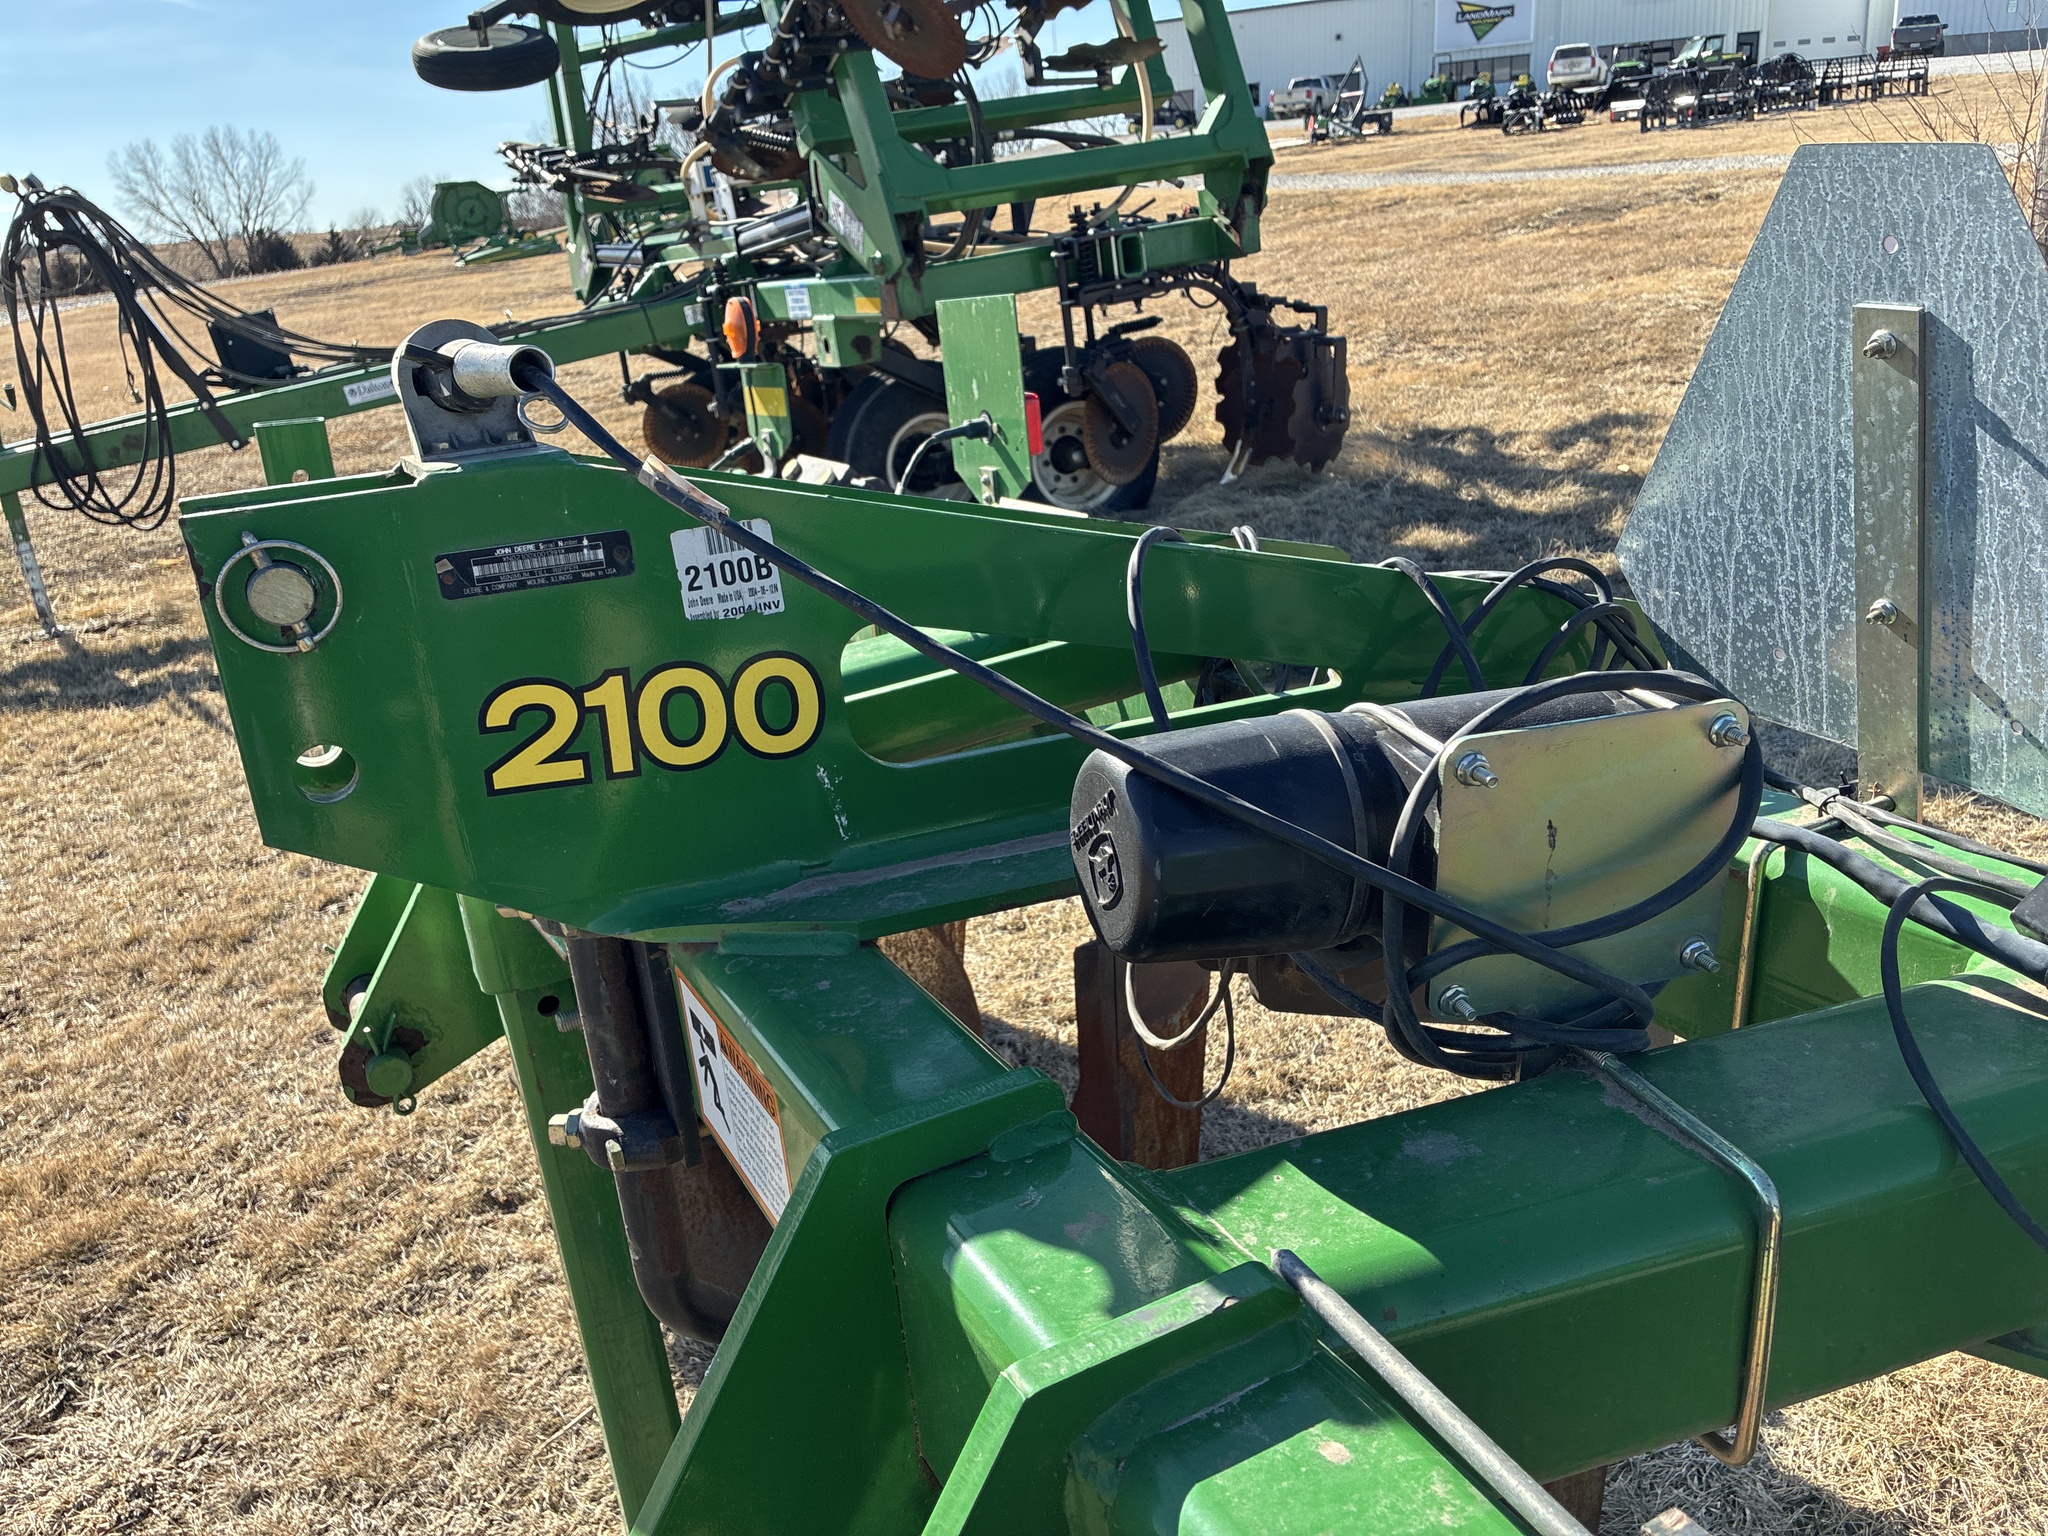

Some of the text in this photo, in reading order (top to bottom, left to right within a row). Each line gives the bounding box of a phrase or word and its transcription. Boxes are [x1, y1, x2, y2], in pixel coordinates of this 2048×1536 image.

[494, 539, 578, 556] JOHN DEERE Serial Number
[463, 586, 483, 595] DEERE
[491, 581, 519, 590] COMPANY
[550, 573, 573, 583] ILLINOIS
[581, 570, 596, 578] Made
[605, 567, 618, 575] USA
[500, 571, 531, 581] MINIMUM
[553, 564, 579, 575] RIPPER
[684, 555, 773, 592] 2100B
[688, 597, 699, 609] John
[699, 595, 714, 606] Deere
[733, 589, 743, 601] USA
[722, 599, 781, 618] 2004 INV
[479, 652, 824, 796] 2100
[727, 1042, 776, 1117] WARNING
